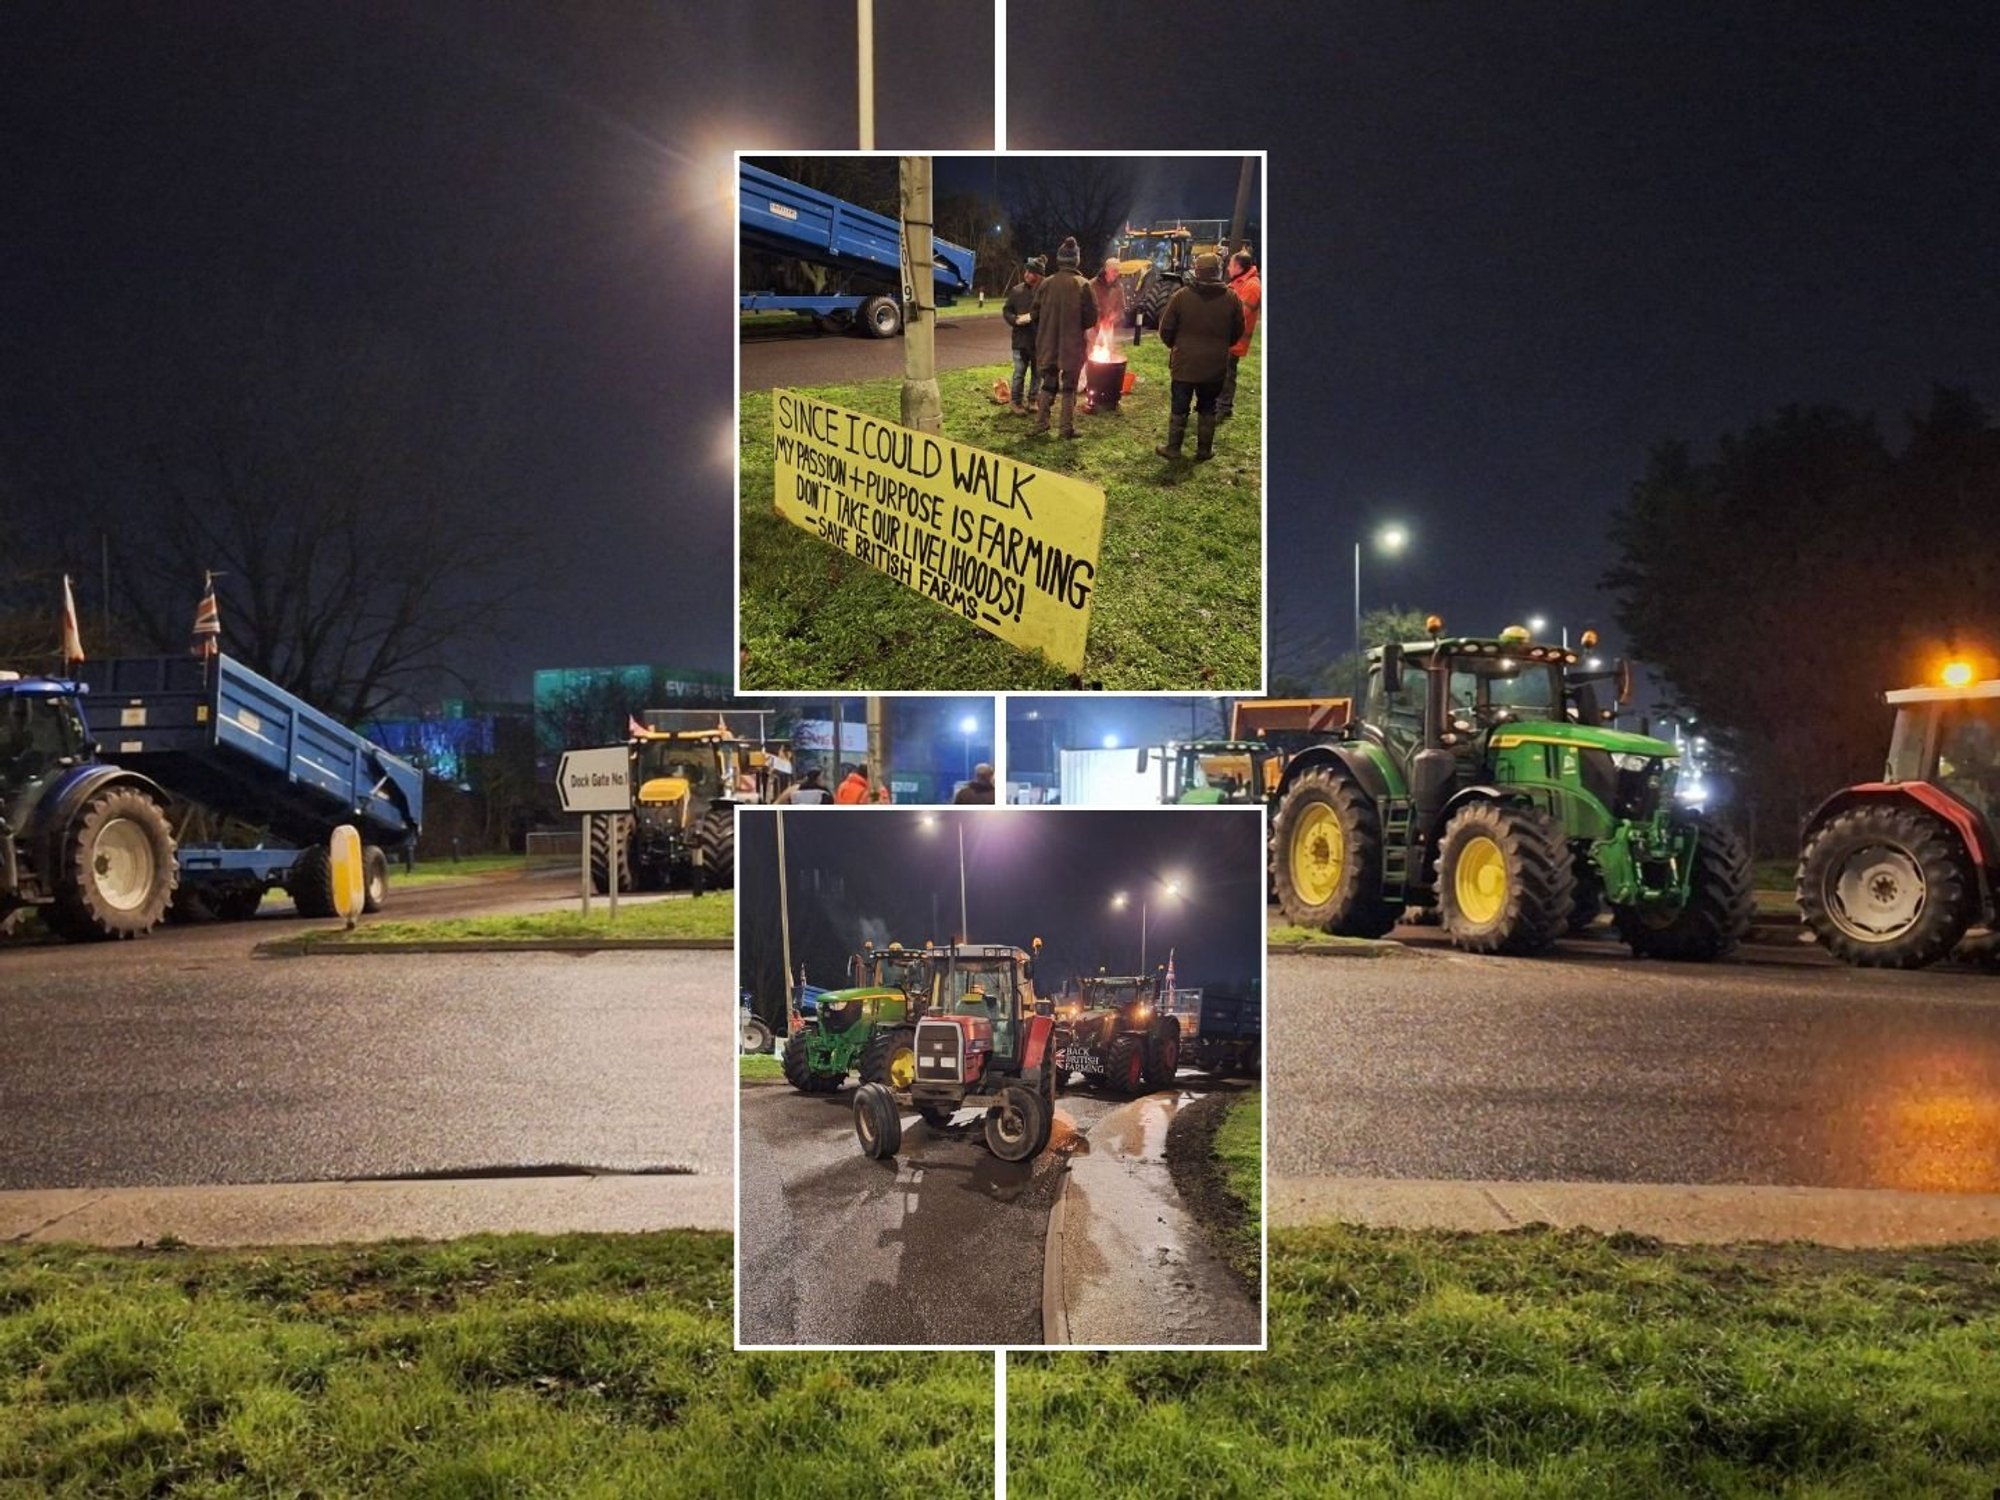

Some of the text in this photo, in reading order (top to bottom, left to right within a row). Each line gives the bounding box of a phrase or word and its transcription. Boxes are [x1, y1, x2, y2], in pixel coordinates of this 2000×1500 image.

[778, 396, 1037, 520] SINCE I COULD WALK
[775, 434, 795, 465] MY
[796, 443, 846, 487] PASSION
[866, 470, 945, 530] PURPOSE
[951, 505, 974, 544] IS
[977, 515, 1096, 610] FARMING
[796, 473, 1026, 623] DON'T TAKE OUR LIVELIHOODS!
[855, 535, 913, 586] BRITISH
[571, 773, 589, 788] Dock
[591, 772, 610, 787] Gate
[1065, 1056, 1099, 1065] BRITISH
[1065, 1063, 1104, 1073] FARMING
[1066, 1047, 1090, 1056] BACK
